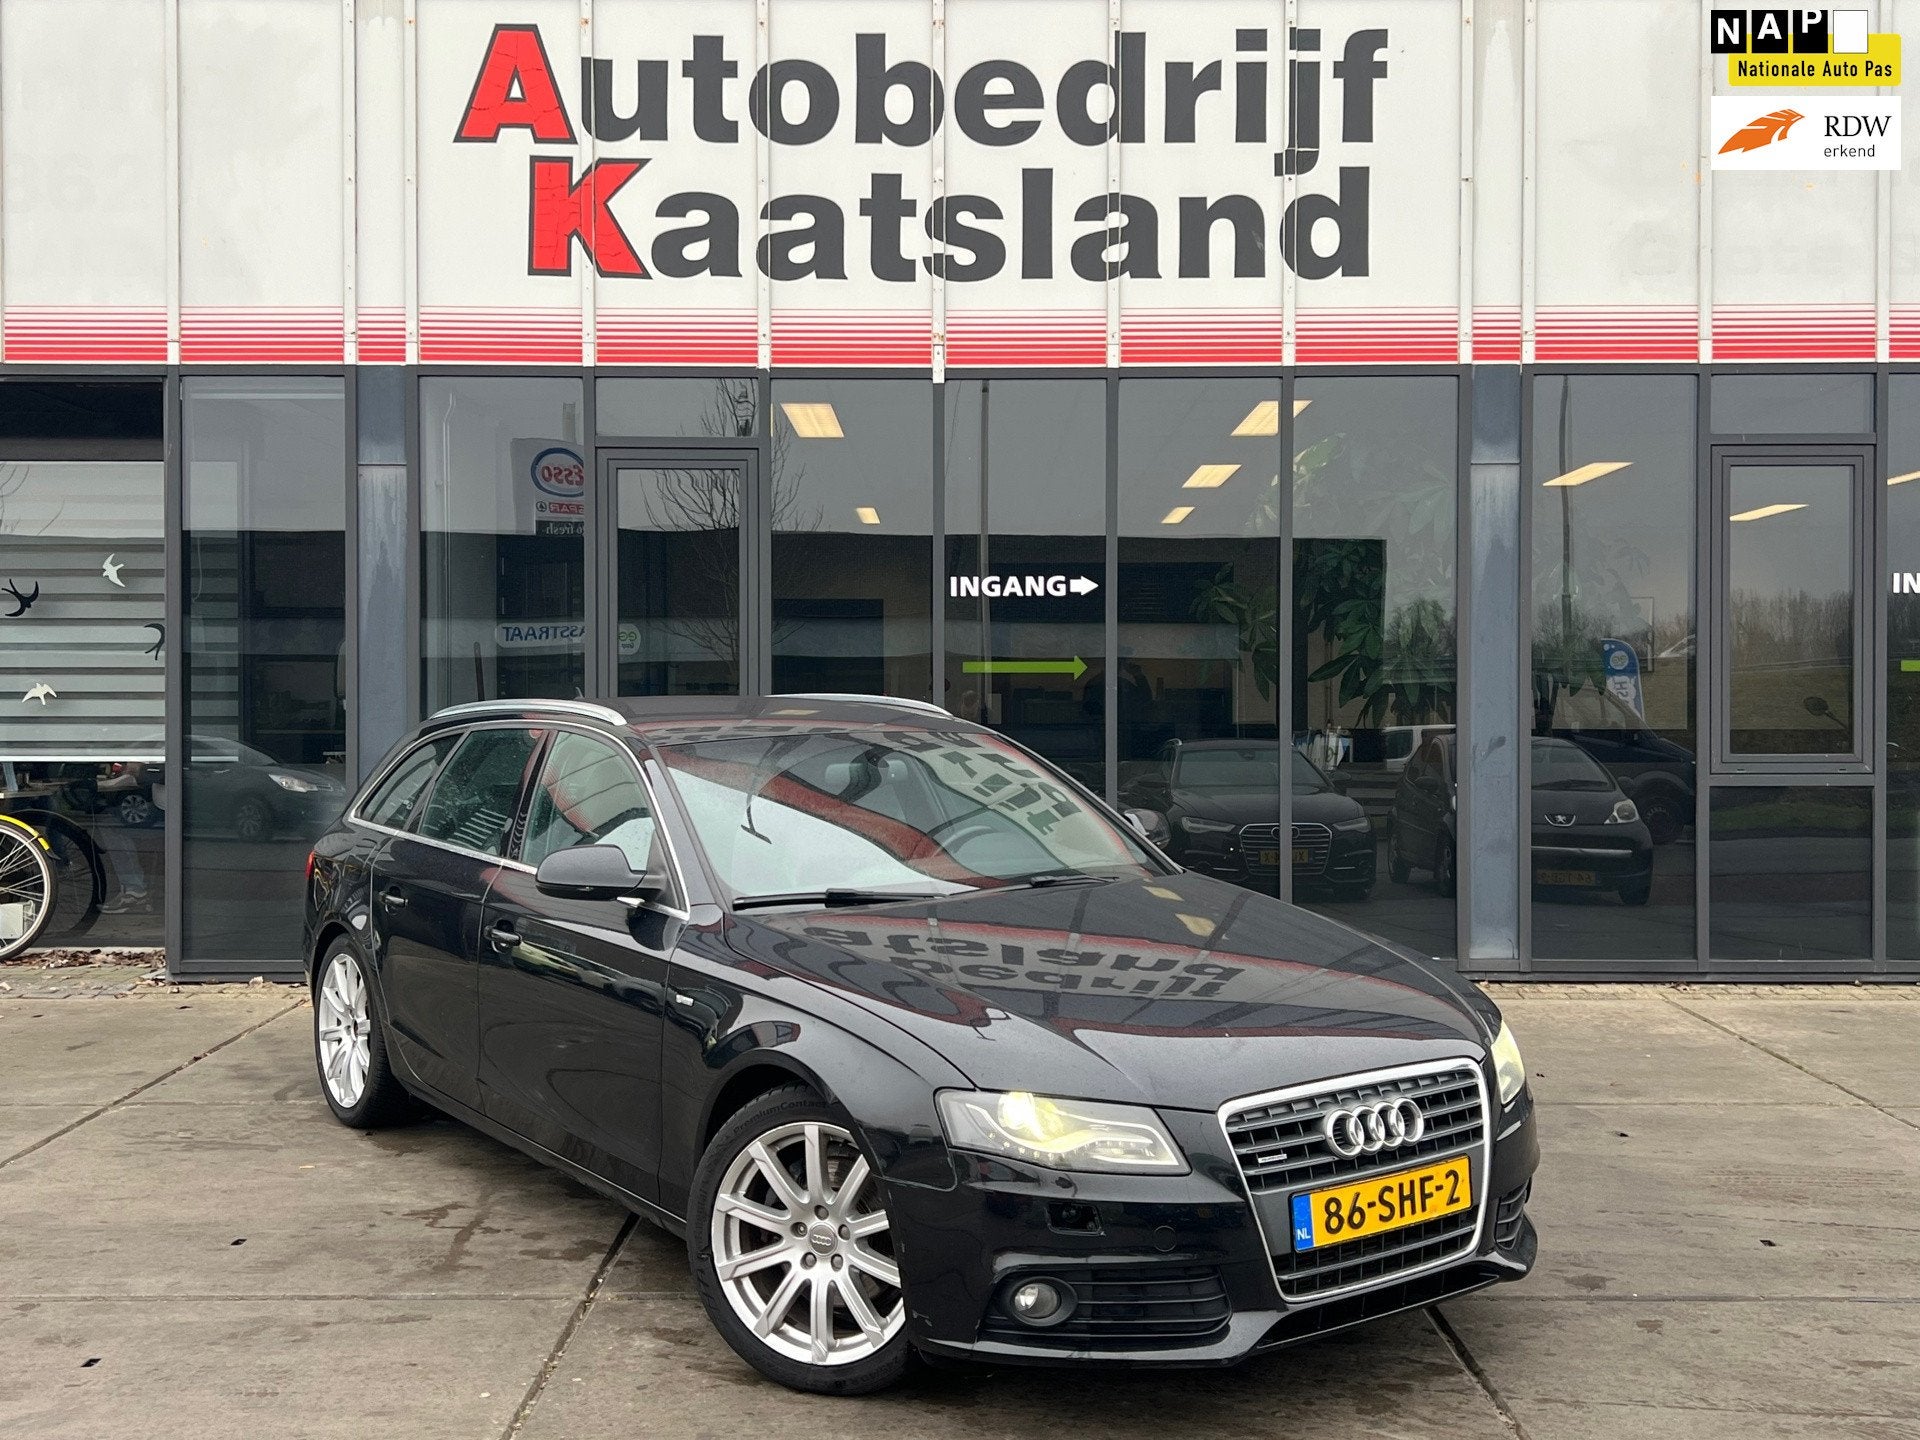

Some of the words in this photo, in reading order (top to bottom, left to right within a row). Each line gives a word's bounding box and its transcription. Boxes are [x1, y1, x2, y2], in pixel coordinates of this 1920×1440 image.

[453, 23, 1388, 177] Autobedrijf
[527, 155, 1370, 282] Kaatsland
[950, 575, 1067, 597] INGANG
[1296, 1228, 1311, 1240] NL
[1324, 1169, 1461, 1235] 86-SHF-2
